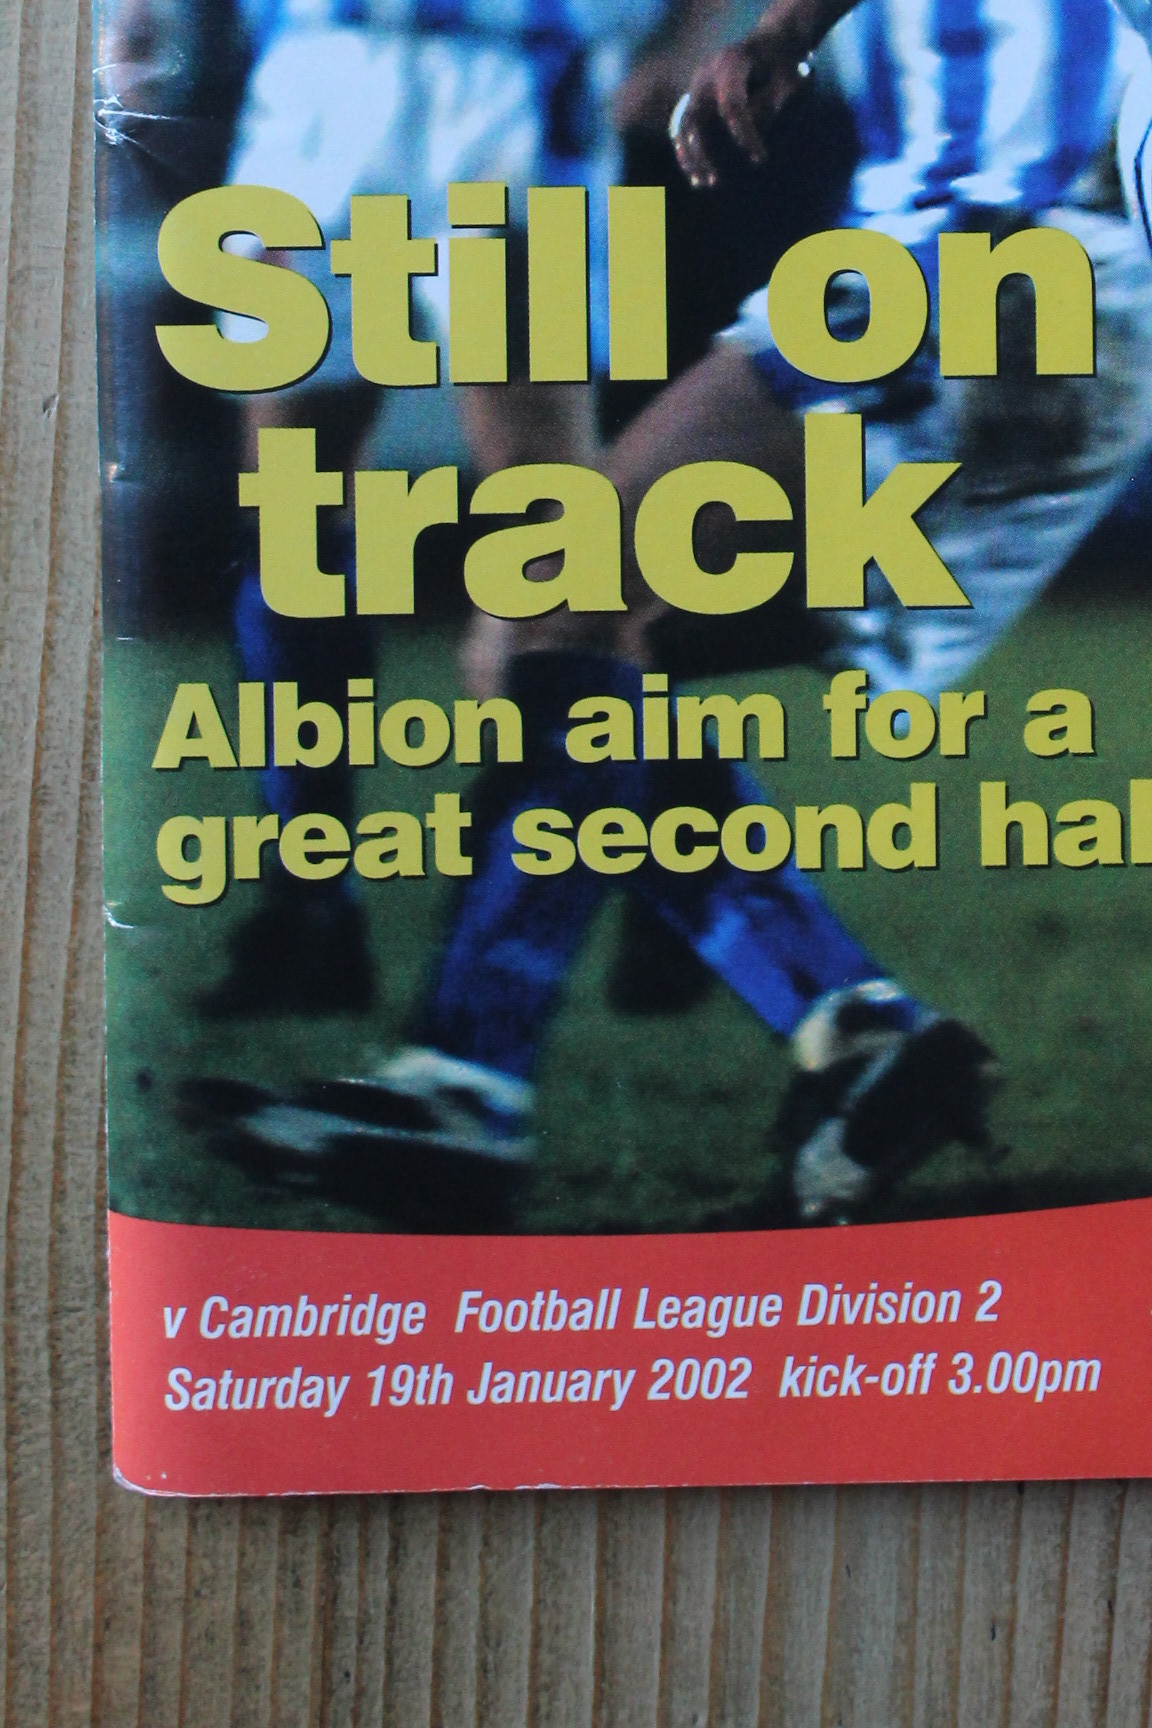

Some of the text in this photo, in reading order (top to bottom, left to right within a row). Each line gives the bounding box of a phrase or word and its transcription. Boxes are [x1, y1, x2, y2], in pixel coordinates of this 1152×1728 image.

[154, 181, 1096, 392] Still on
[239, 413, 974, 619] track
[152, 671, 1096, 770] Albion aim for a
[155, 794, 474, 906] great
[511, 782, 939, 876] second
[163, 1279, 1002, 1345] v Cambridge Football League Division 2
[164, 1351, 1102, 1418] Saturday 19th January 2002 kick-off 3.00pm
